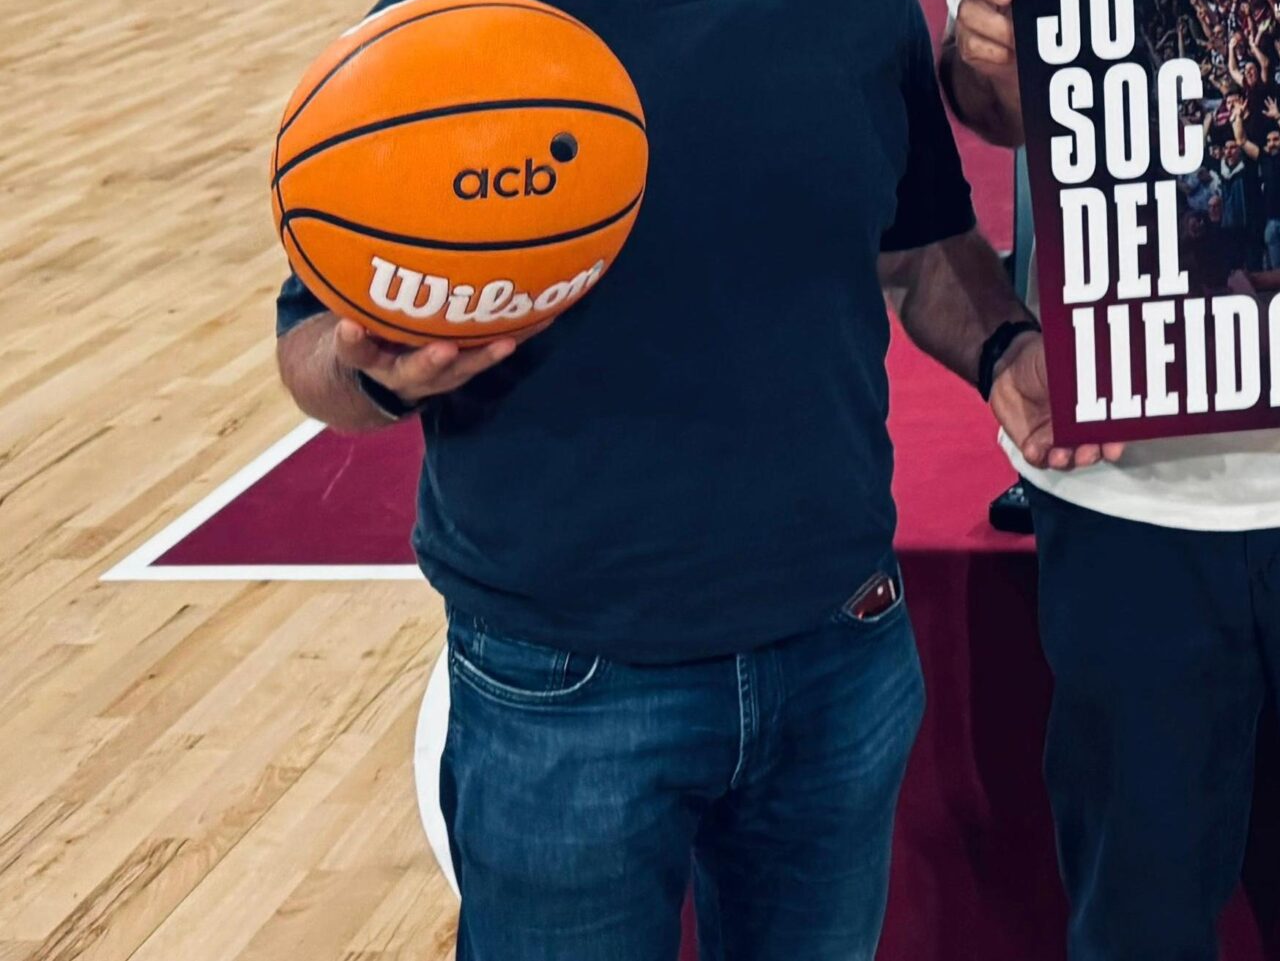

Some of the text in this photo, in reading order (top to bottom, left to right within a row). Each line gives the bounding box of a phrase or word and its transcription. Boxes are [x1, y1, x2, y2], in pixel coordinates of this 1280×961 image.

[1049, 57, 1204, 185] SOC
[452, 158, 558, 200] acb
[369, 255, 606, 324] Wilson
[1059, 180, 1189, 305] DEL
